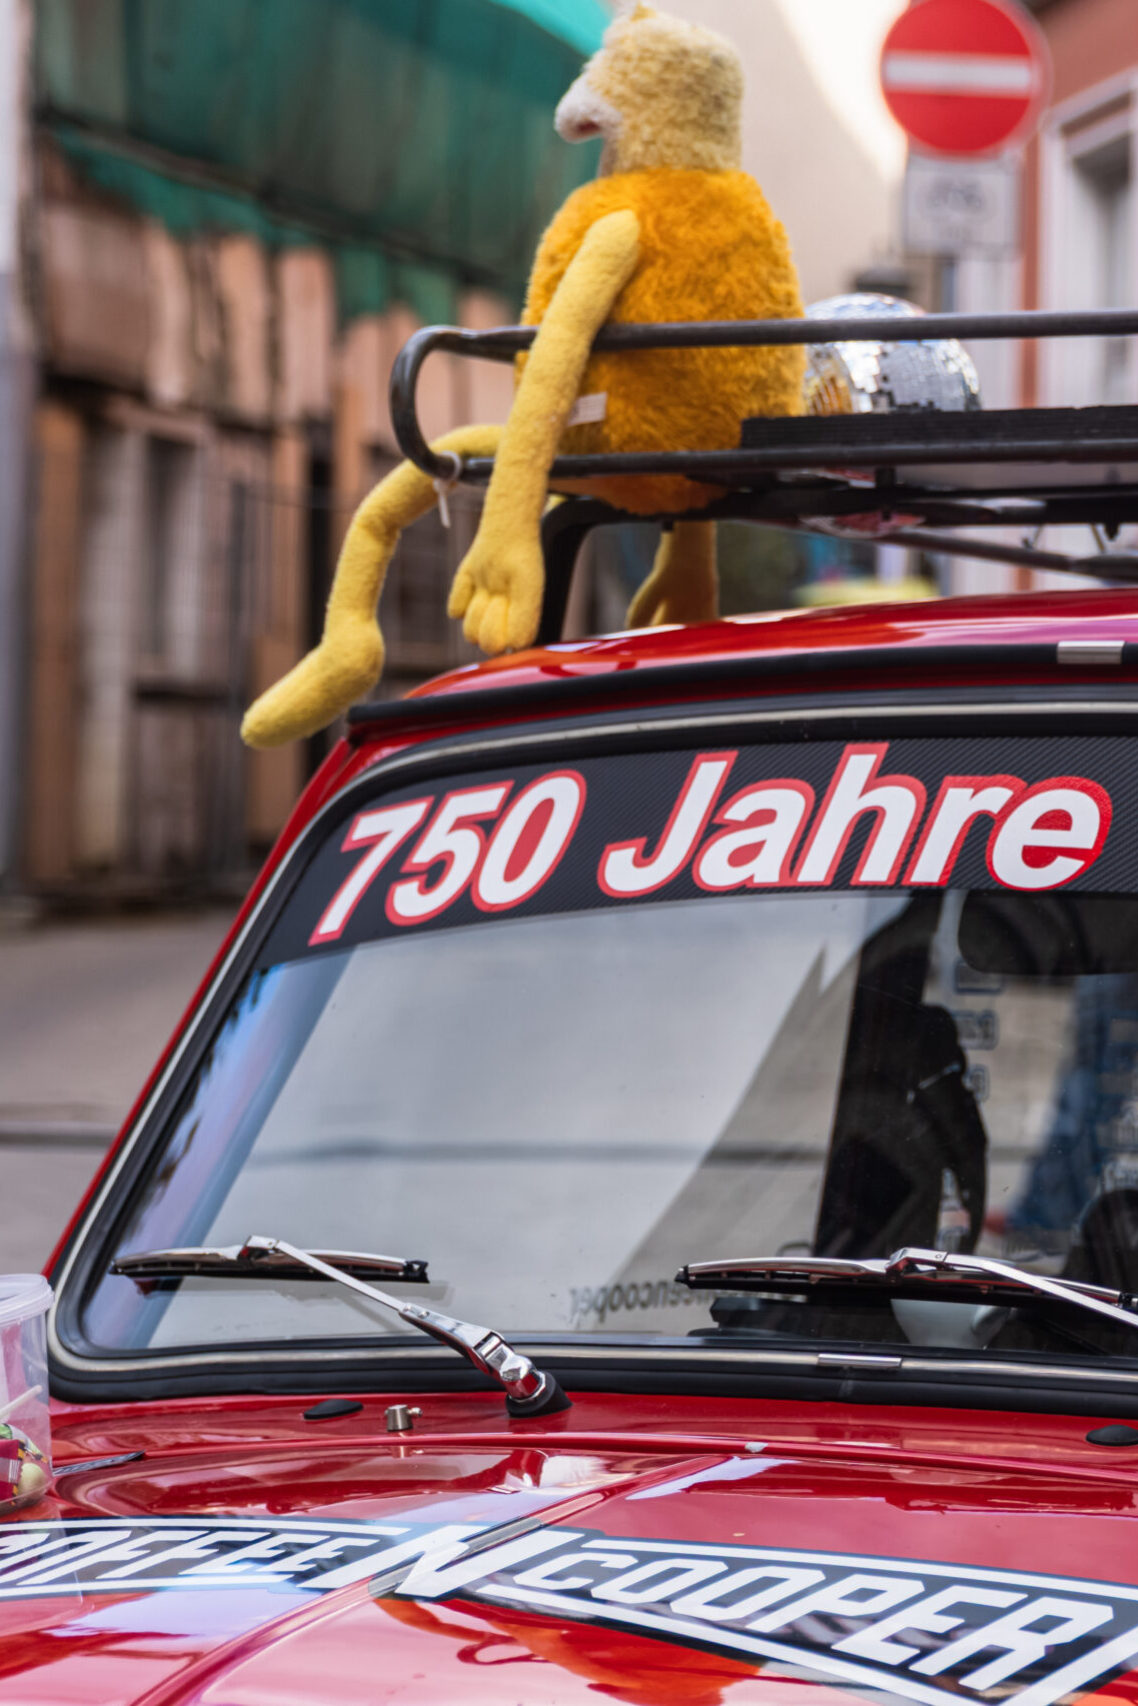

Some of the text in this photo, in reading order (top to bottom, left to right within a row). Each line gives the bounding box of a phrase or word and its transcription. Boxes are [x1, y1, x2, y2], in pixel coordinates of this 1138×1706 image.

[308, 769, 588, 948] 750
[597, 742, 1114, 898] Jahre
[513, 1550, 1114, 1692] COOPER
